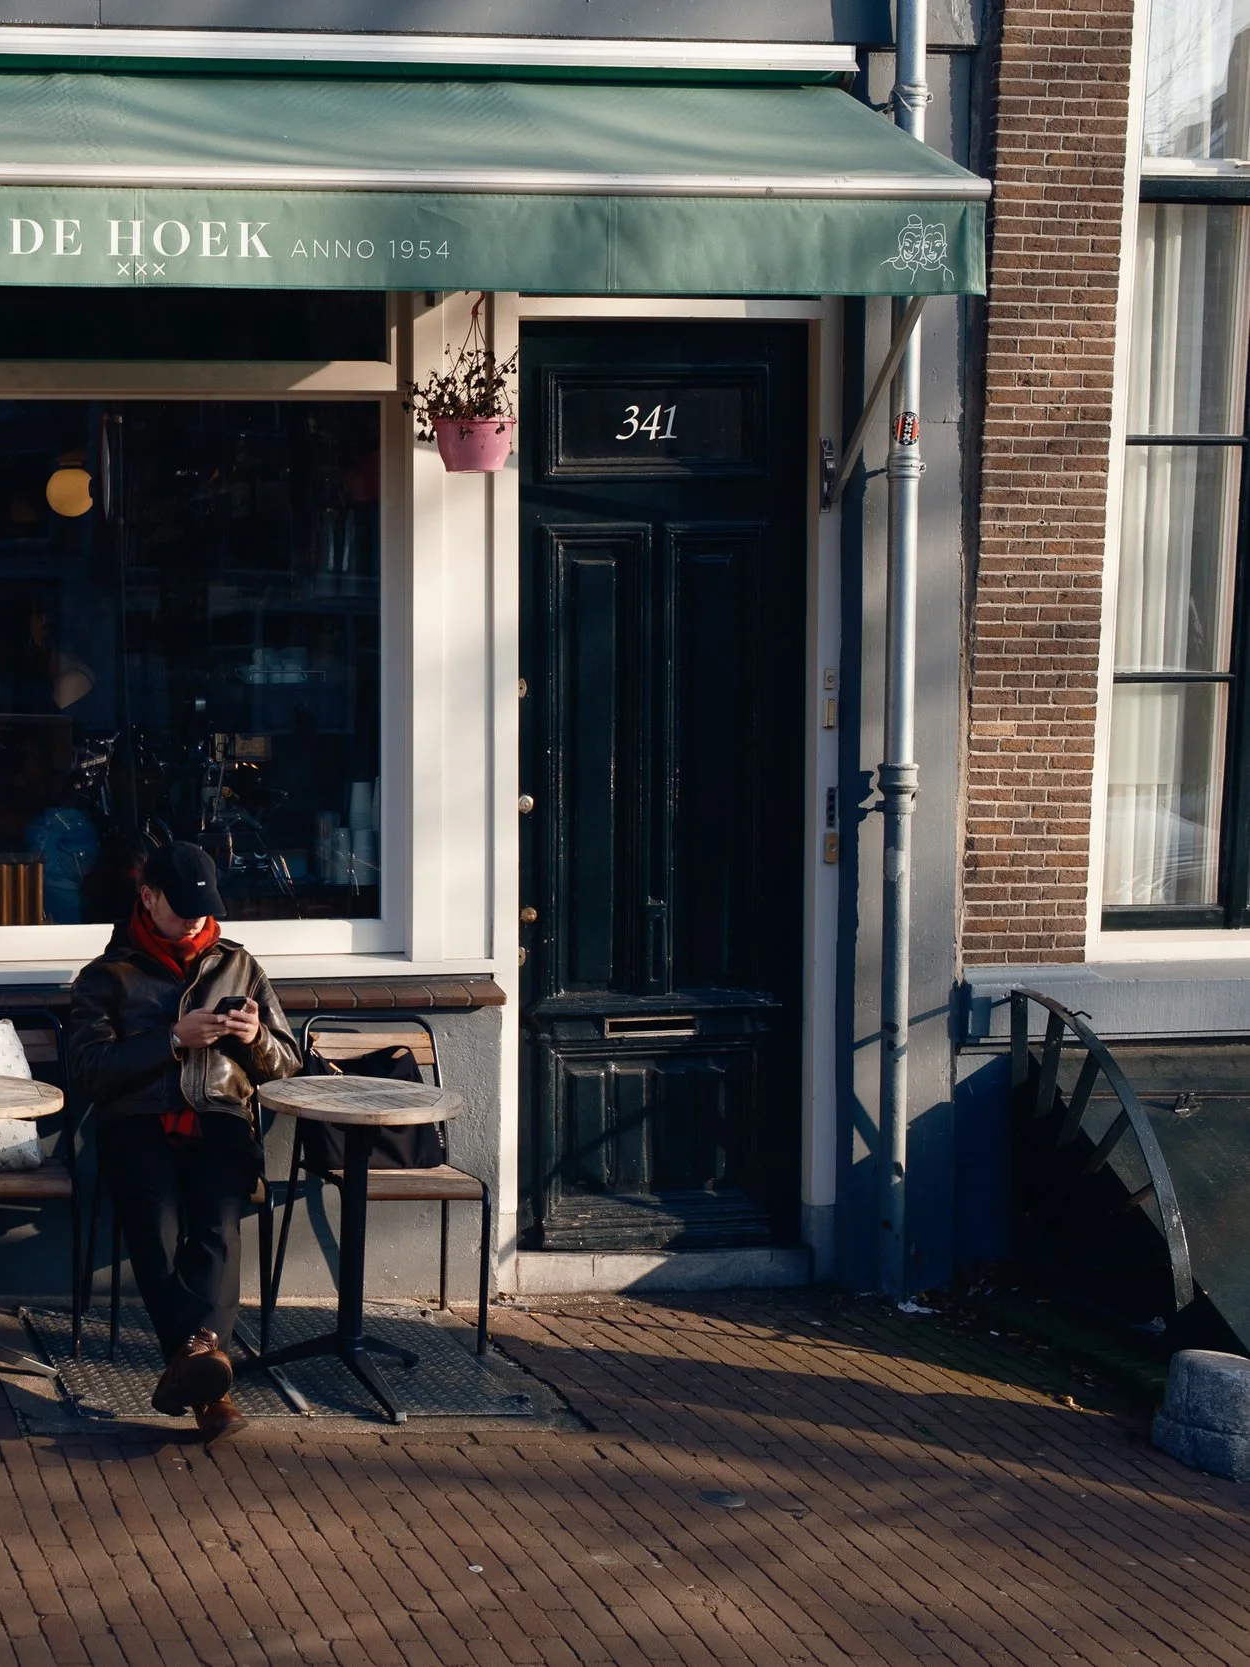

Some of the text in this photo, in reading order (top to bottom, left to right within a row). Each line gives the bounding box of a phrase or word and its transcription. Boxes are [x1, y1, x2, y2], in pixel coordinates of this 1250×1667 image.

[9, 218, 83, 256] DE
[106, 219, 273, 258] HOEK
[290, 238, 375, 259] ANNO
[388, 239, 450, 260] 1954
[615, 404, 678, 441] 341
